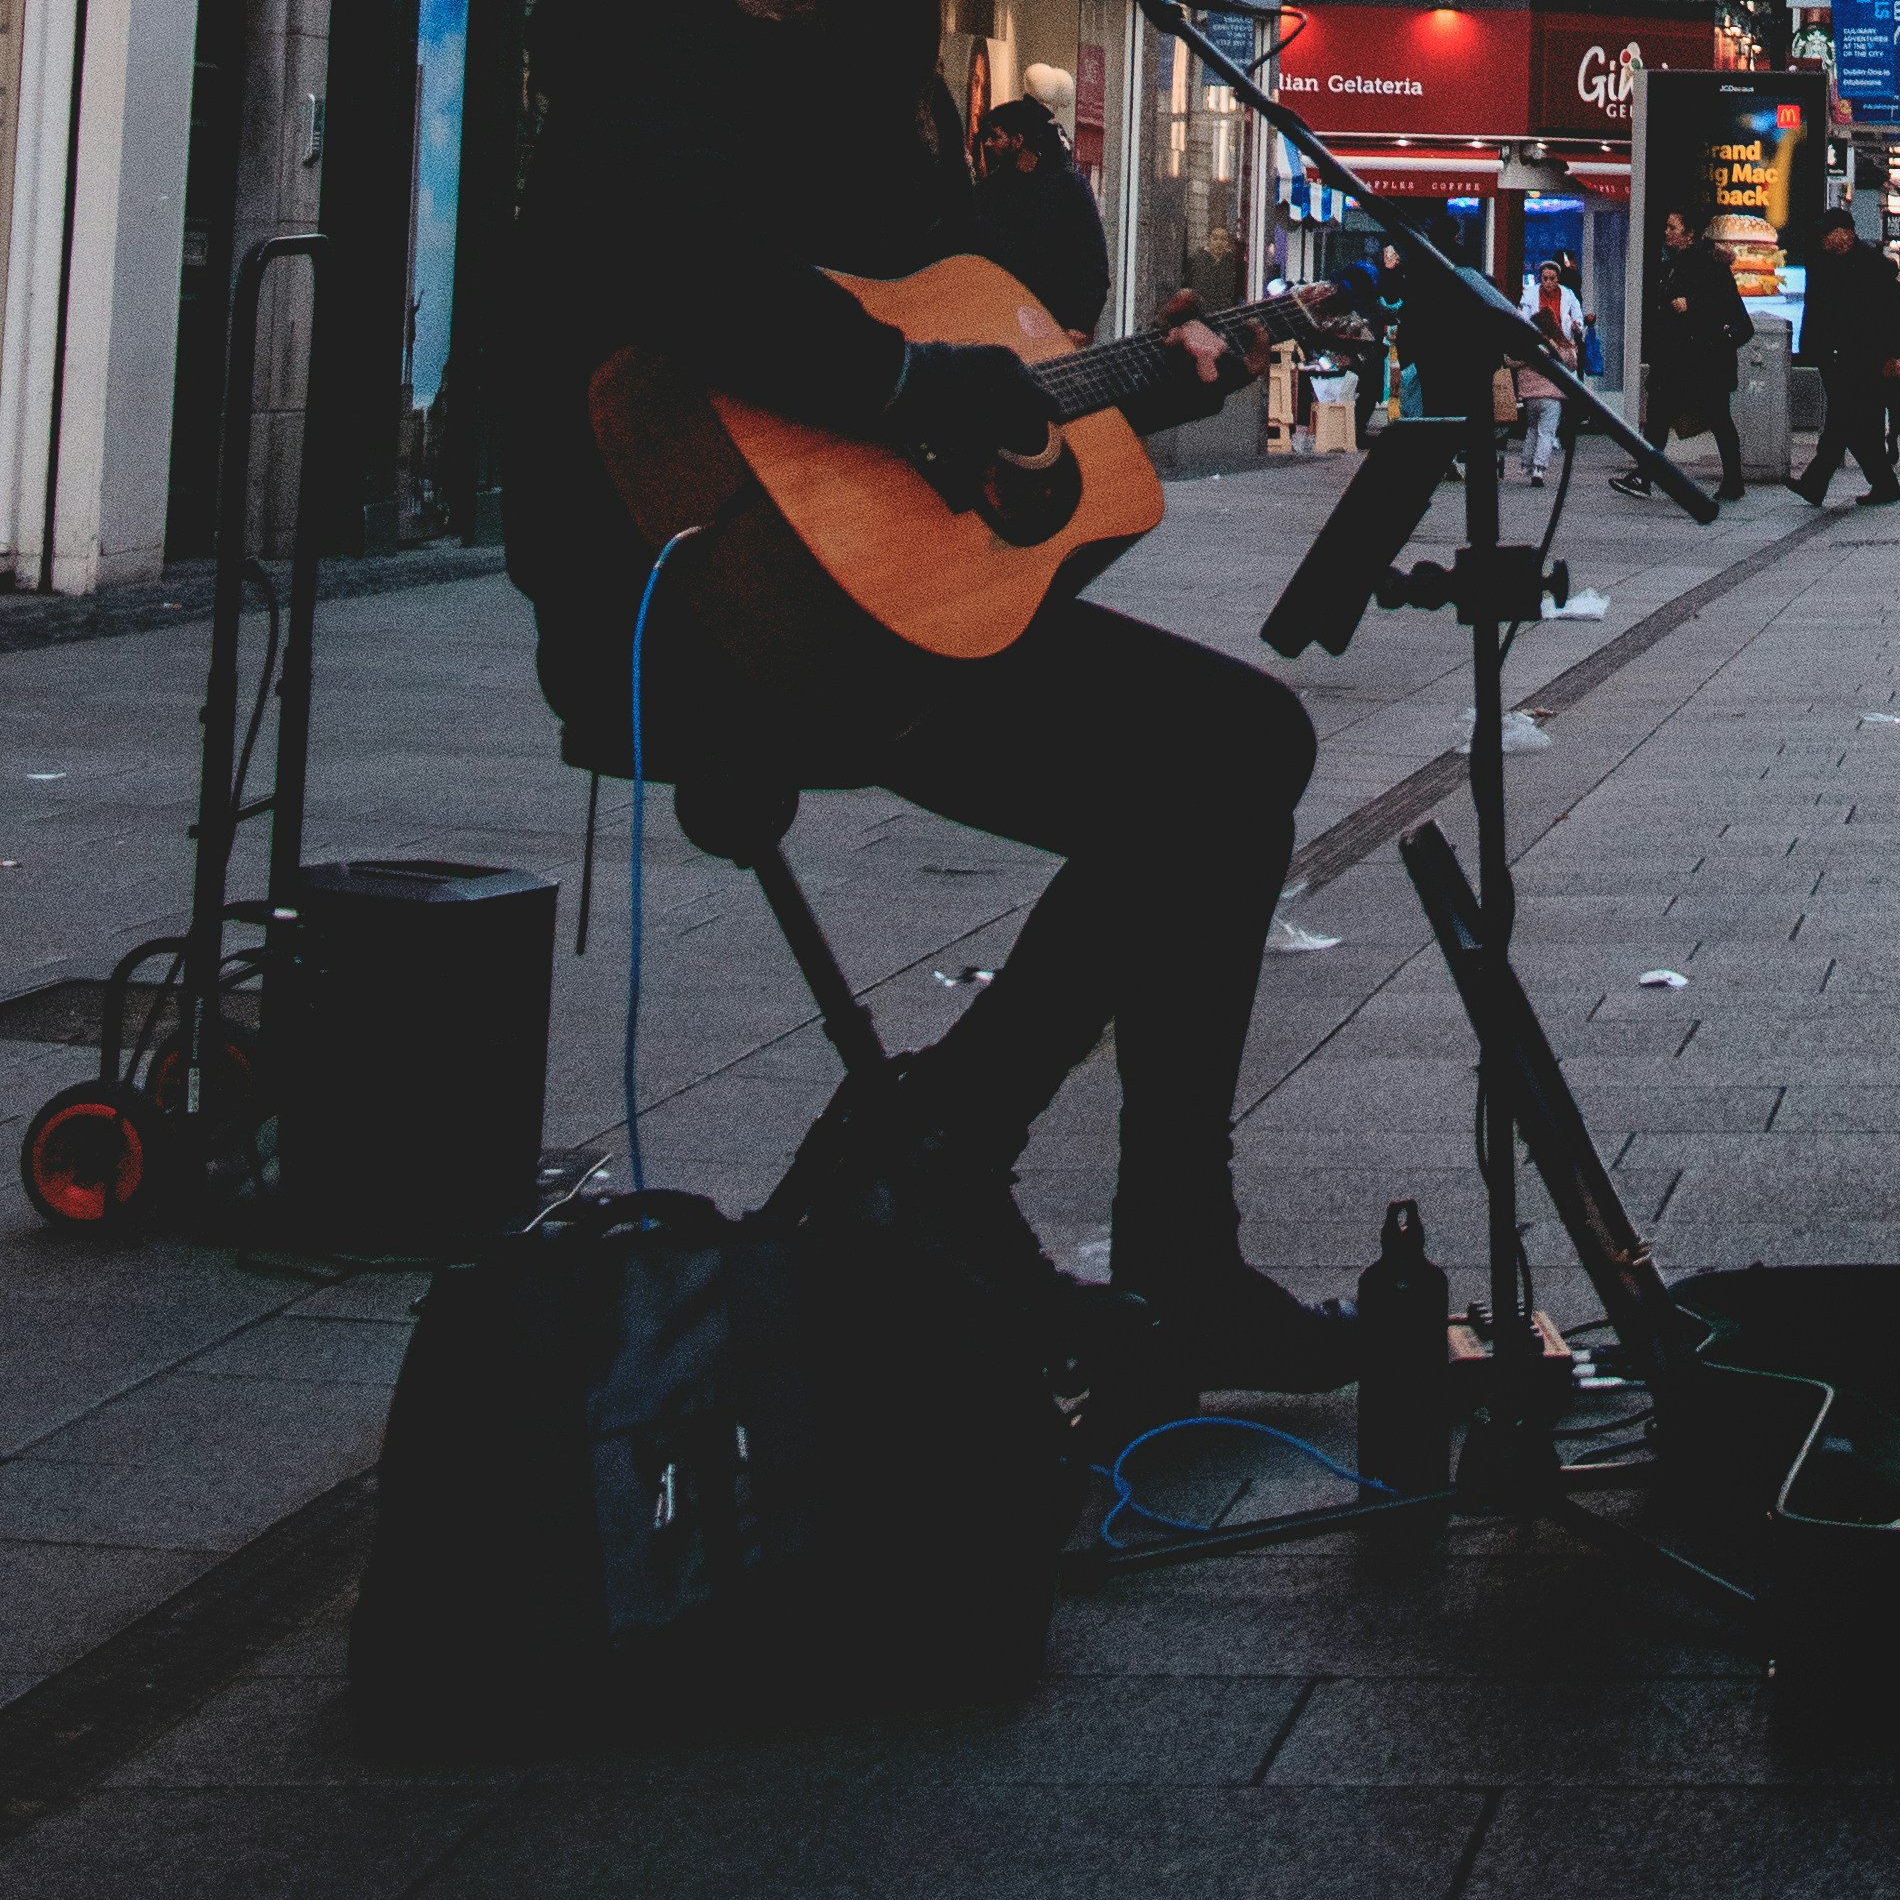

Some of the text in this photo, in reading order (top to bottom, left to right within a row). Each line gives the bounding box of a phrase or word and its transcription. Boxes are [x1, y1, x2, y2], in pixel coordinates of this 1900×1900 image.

[1328, 75, 1423, 96] Gelateria
[1732, 163, 1779, 184] Mac
[1432, 182, 1480, 192] COFFEE
[1717, 185, 1770, 206] back
